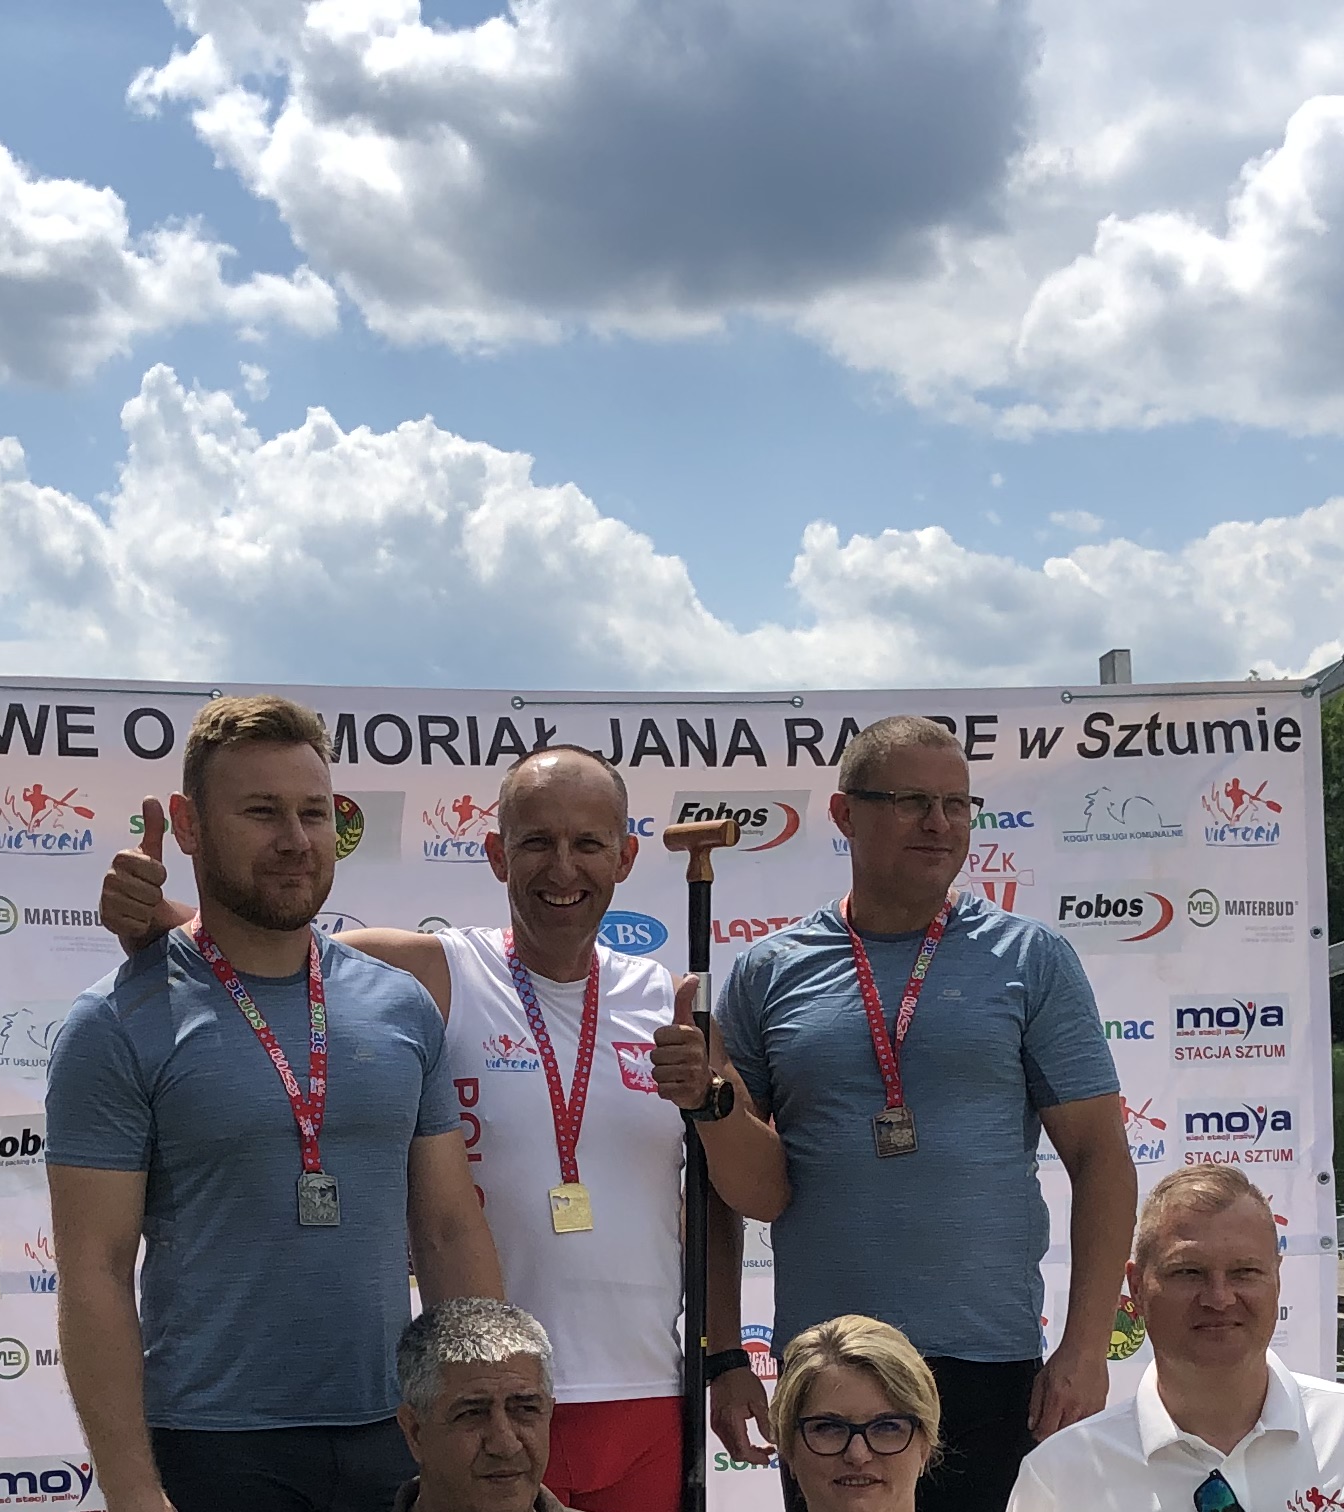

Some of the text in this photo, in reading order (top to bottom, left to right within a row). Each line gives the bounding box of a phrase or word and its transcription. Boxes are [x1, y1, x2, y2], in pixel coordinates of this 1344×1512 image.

[124, 707, 175, 760] O
[316, 713, 557, 766] MORIAŁ
[593, 717, 768, 768] JANA
[784, 714, 998, 767] RAE
[1019, 726, 1064, 759] w
[1077, 707, 1302, 759] Sztumie
[970, 809, 1035, 829] nac
[969, 844, 1016, 873] PZK
[25, 908, 103, 926] MATERBU
[1058, 893, 1144, 921] Fobos
[710, 917, 803, 943] LAST
[912, 937, 938, 980] sonac
[226, 978, 267, 1030] sonac
[311, 1001, 327, 1054] sonac
[1104, 1019, 1154, 1040] nac
[1176, 998, 1284, 1041] moya
[1174, 1044, 1286, 1061] STACJA SZTUM
[1185, 1103, 1292, 1145] moya
[1184, 1148, 1294, 1166] STACJA SZTUM
[743, 1259, 773, 1268] USŁUG
